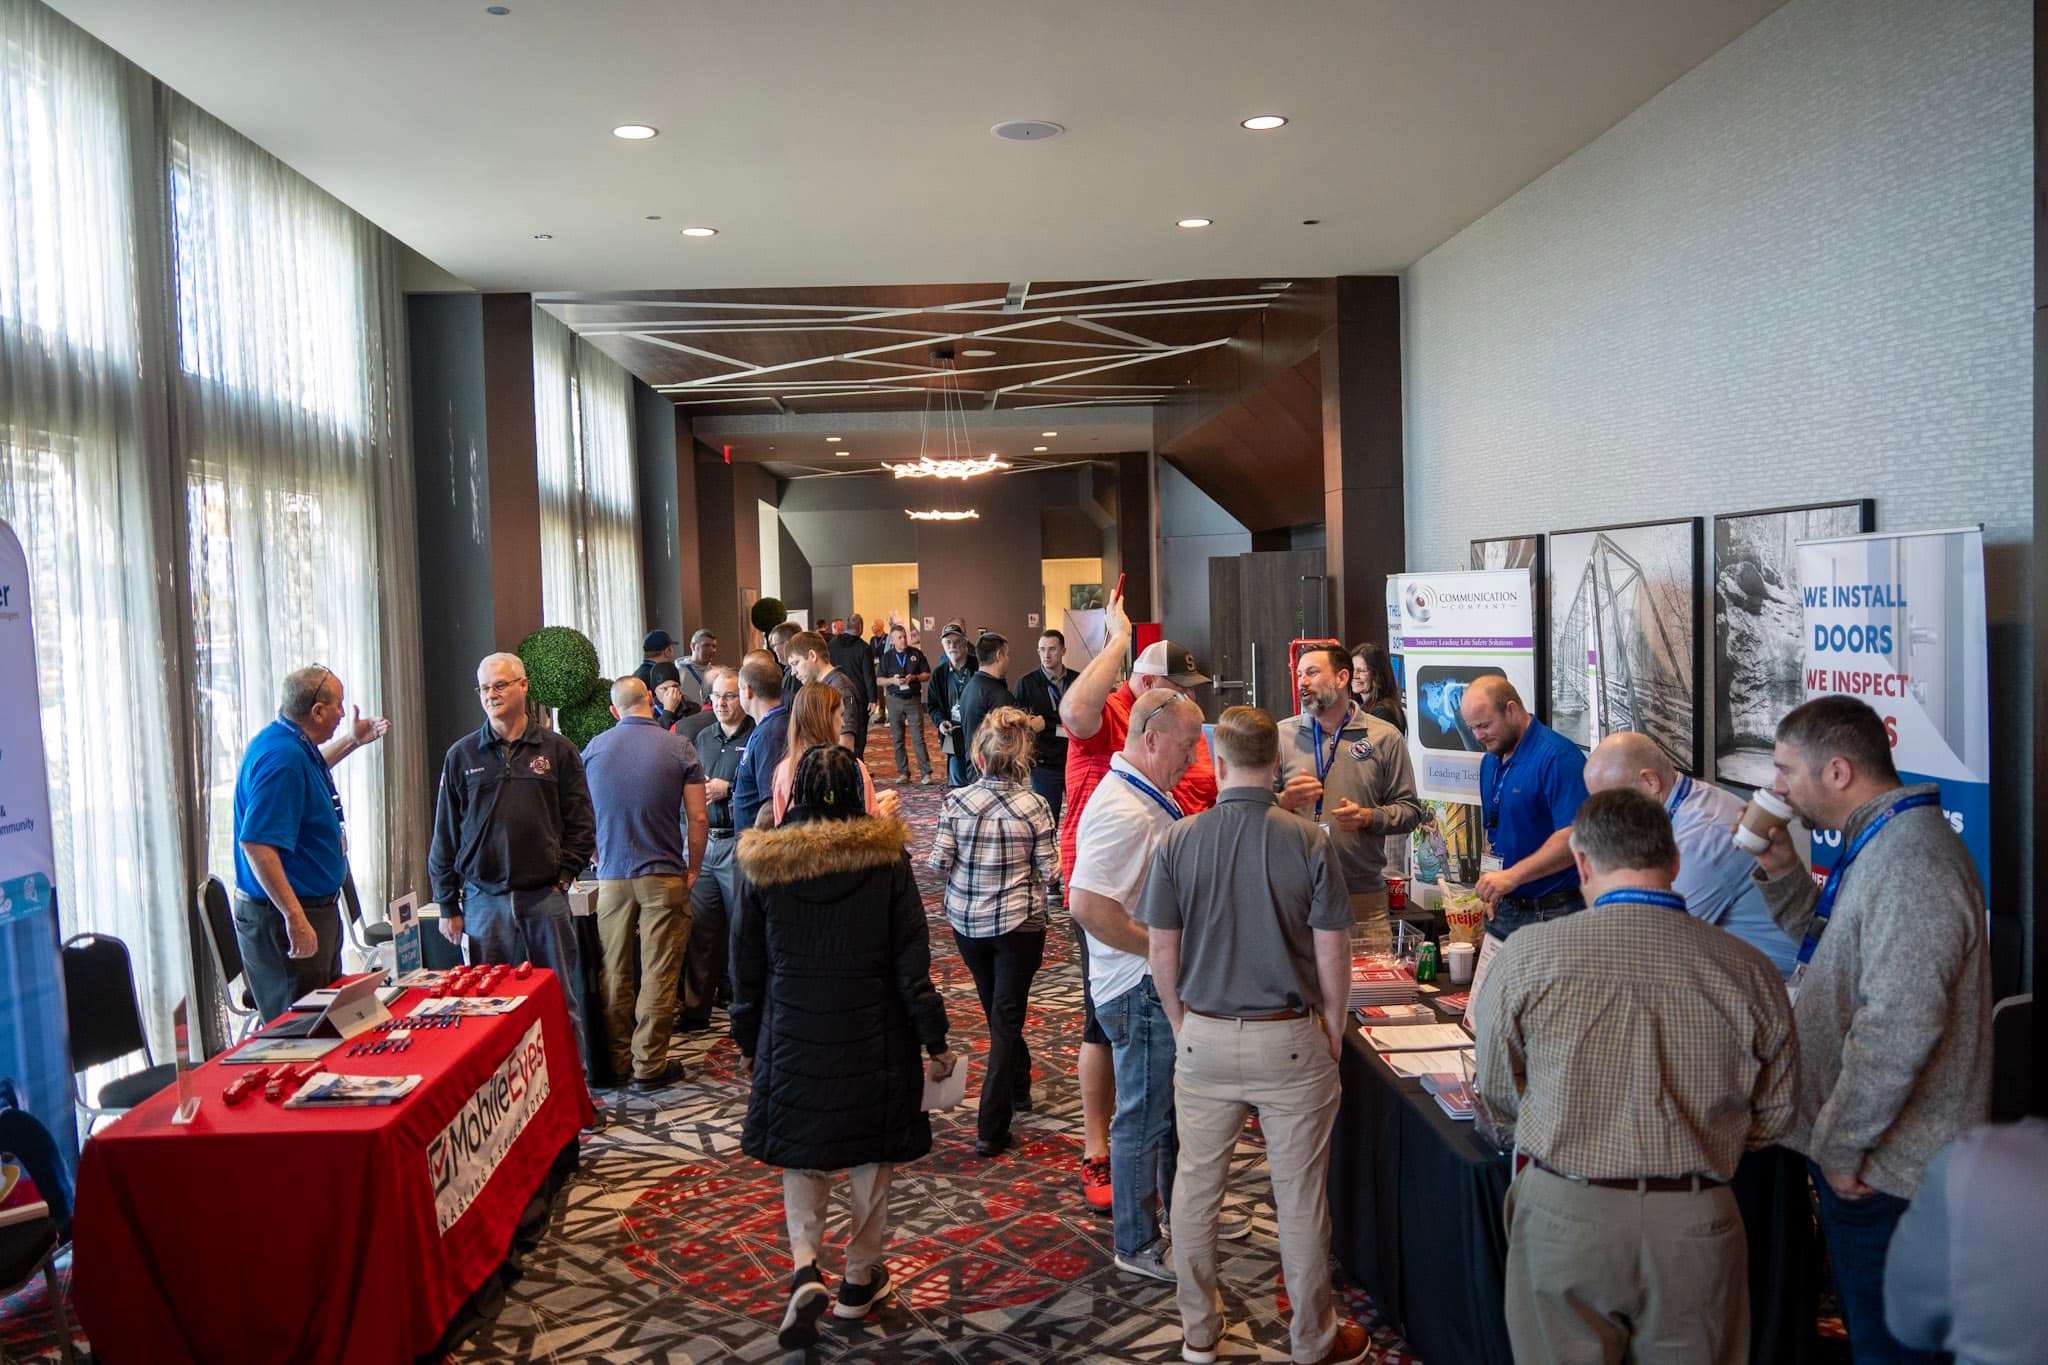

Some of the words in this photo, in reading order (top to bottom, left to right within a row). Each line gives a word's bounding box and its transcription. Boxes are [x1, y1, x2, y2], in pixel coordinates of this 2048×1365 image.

[1440, 591, 1517, 602] COMMUNICATION
[1804, 586, 1827, 608] WE
[1832, 583, 1908, 608] INSTALL
[1439, 638, 1459, 647] Leading
[1815, 624, 1893, 655] DOORS
[1806, 669, 1828, 691] WE
[1832, 670, 1909, 698] INSPECT
[1429, 766, 1460, 780] Leading
[0, 816, 34, 836] mmunity
[448, 1033, 544, 1178] MobileEyes
[441, 1171, 487, 1229] NABLING
